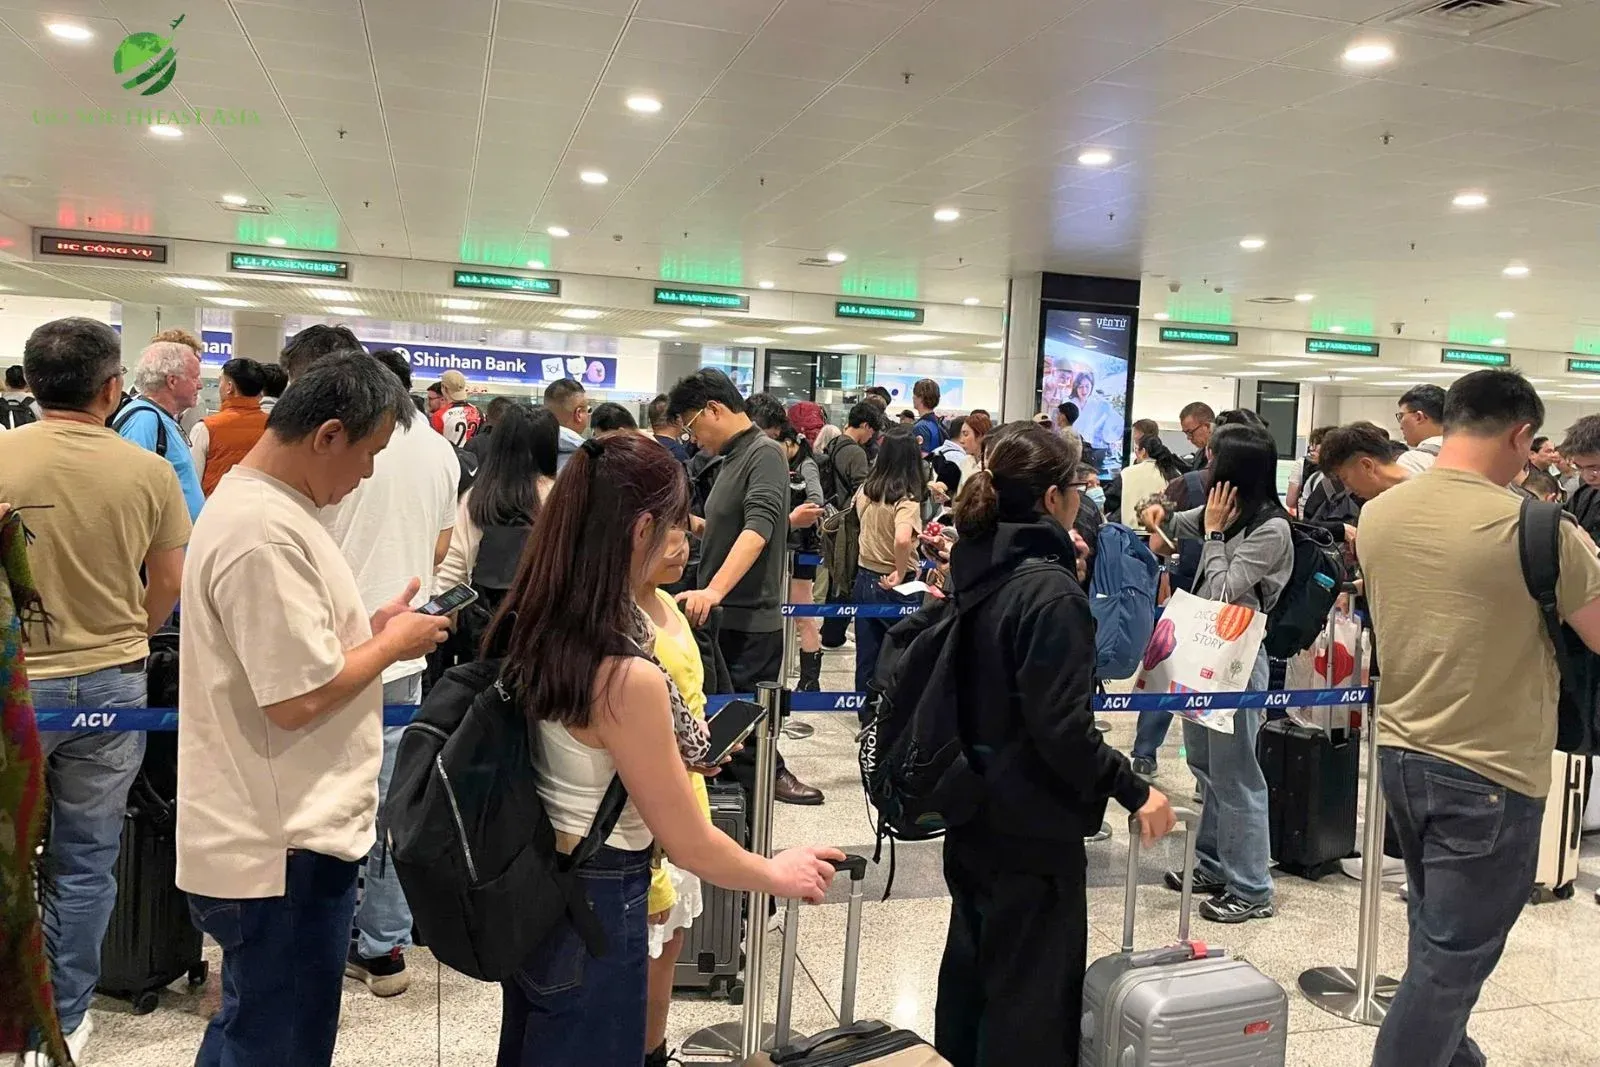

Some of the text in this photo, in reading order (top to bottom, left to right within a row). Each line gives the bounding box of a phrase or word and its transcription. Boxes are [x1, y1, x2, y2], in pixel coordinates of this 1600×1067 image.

[233, 257, 337, 273] ALL PASSENGERS
[413, 351, 527, 373] Shinhan Bank
[781, 605, 796, 615] CV
[837, 606, 858, 615] ACV
[1193, 632, 1226, 649] STORY
[834, 695, 867, 708] ACV
[1103, 690, 1366, 709] ACV ACV ACV ACV
[71, 712, 118, 728] ACV
